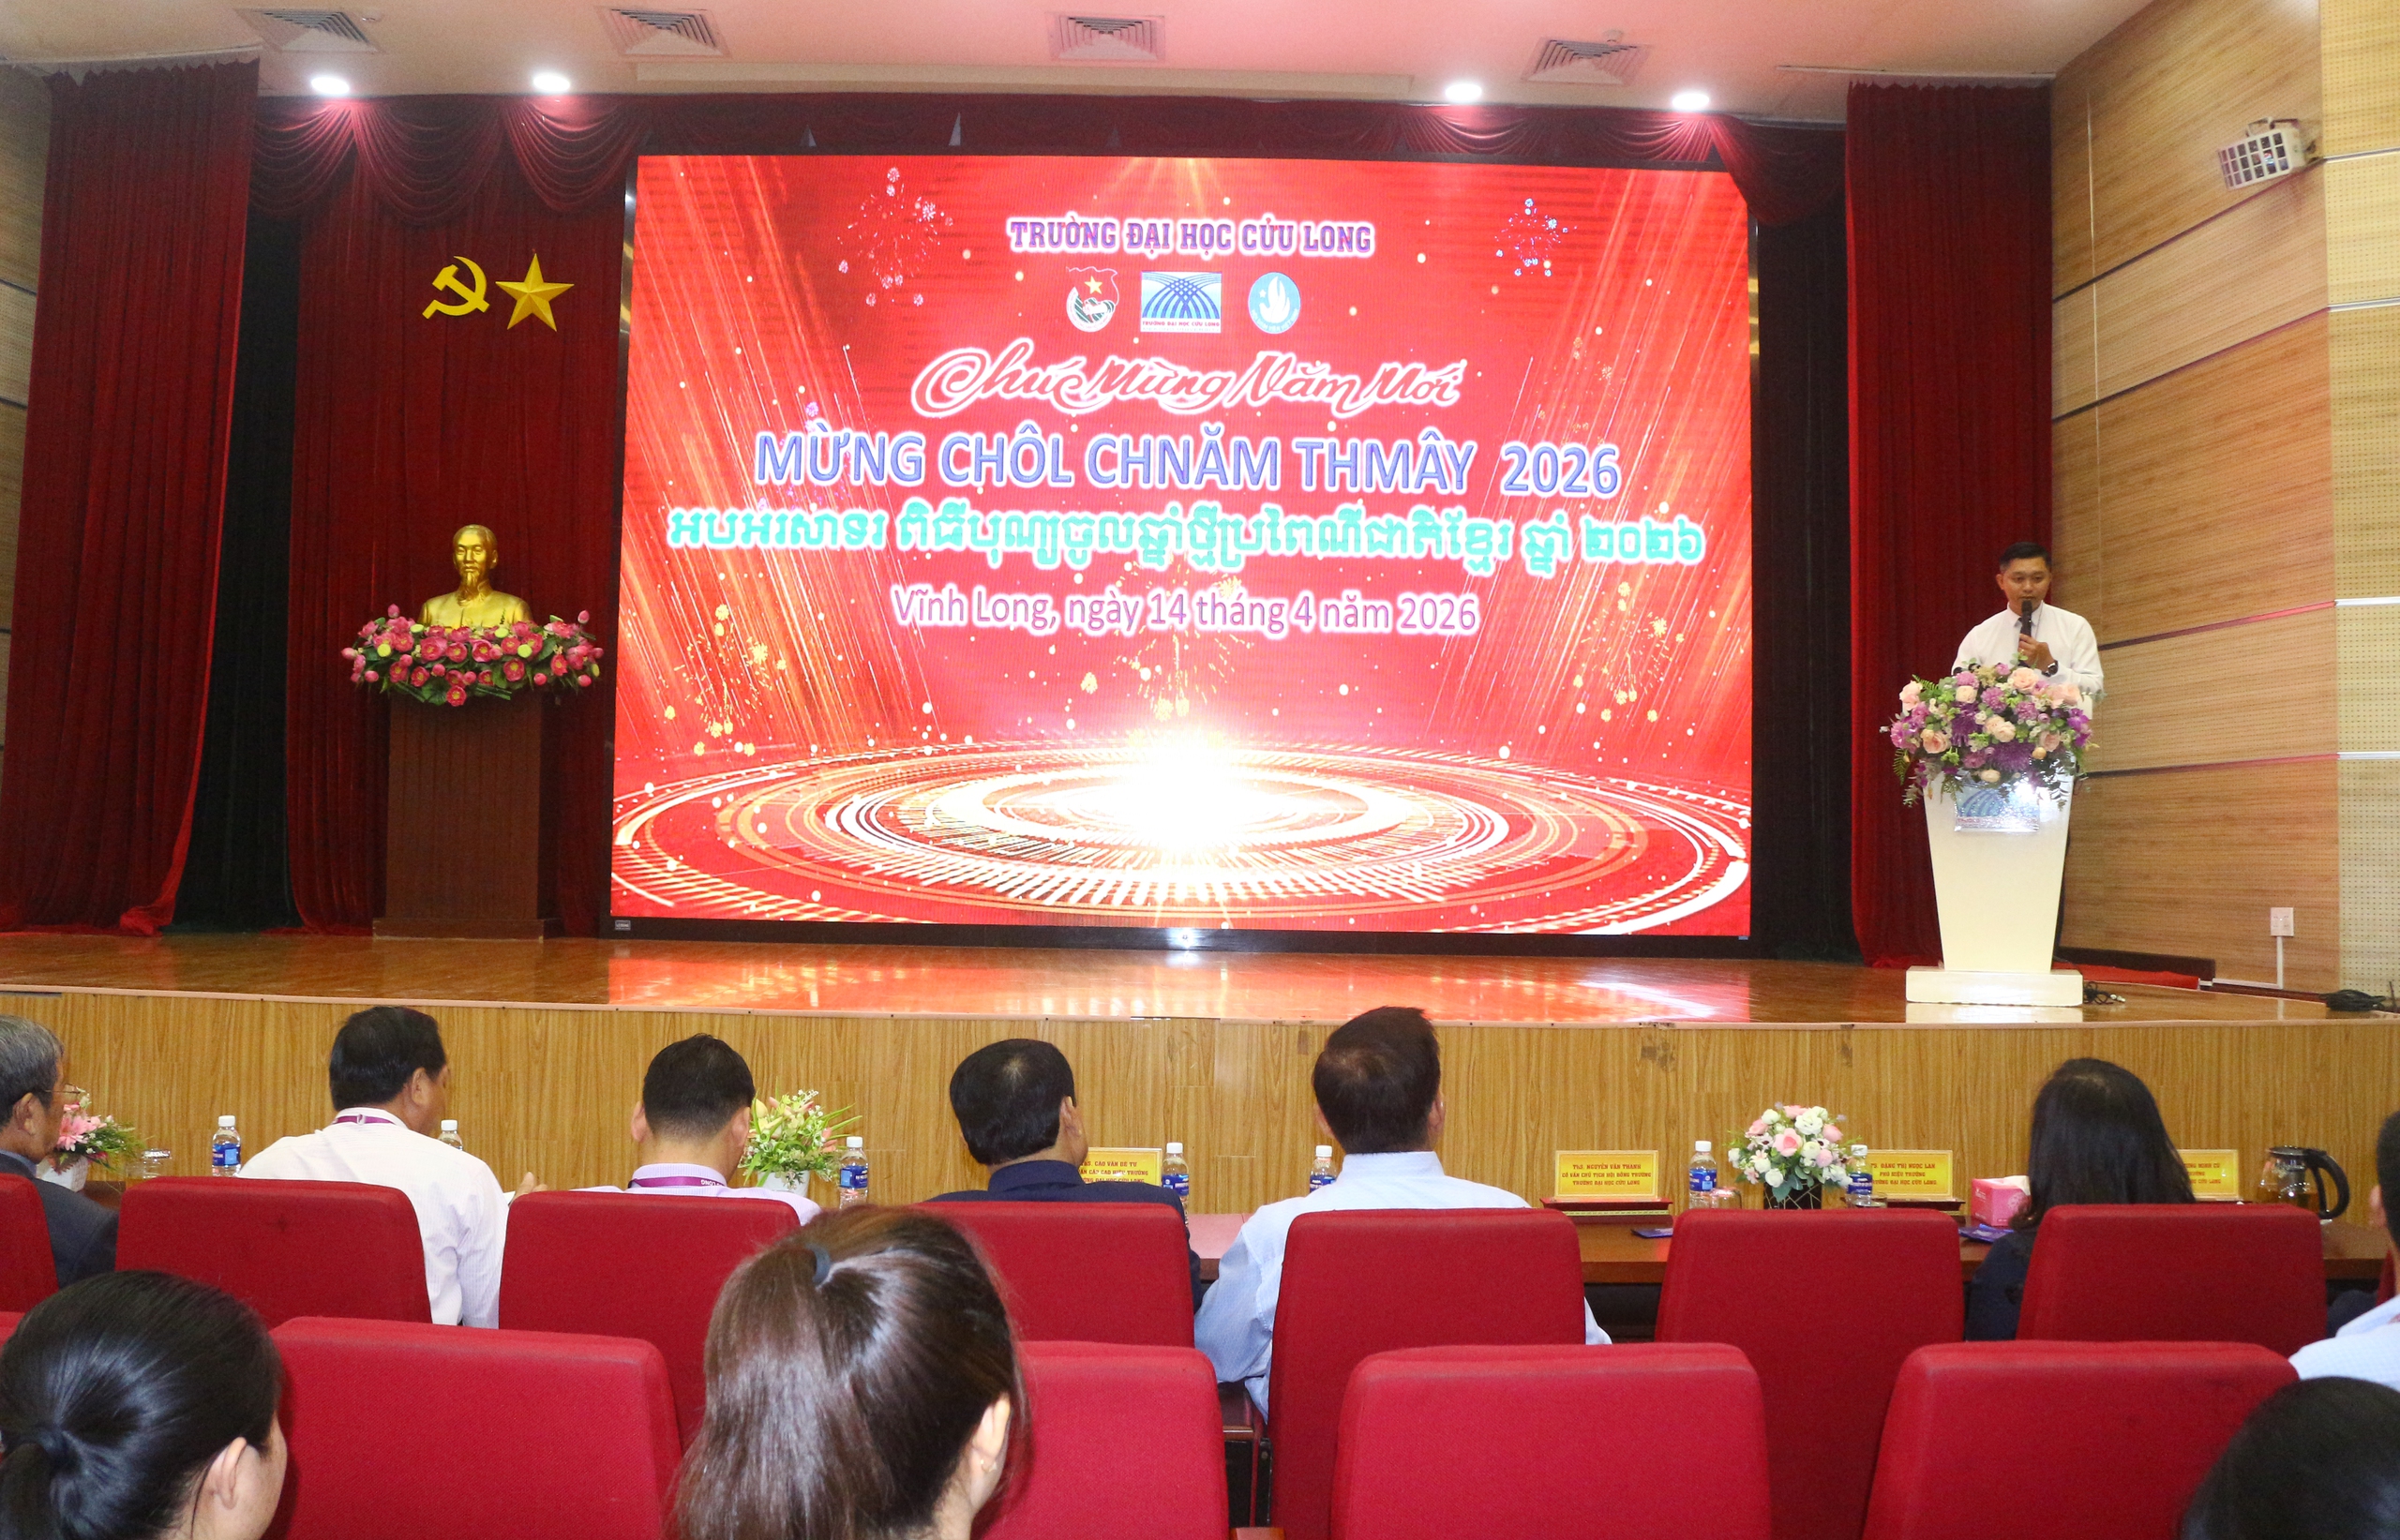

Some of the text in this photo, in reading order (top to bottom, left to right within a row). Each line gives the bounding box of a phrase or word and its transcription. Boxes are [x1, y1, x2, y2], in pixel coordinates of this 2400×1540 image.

[1010, 216, 1372, 256] TRƯỜNG ĐẠI HỌC CỬU LONG
[912, 338, 1462, 414] Chúc Mừng Năm Mới
[757, 422, 1620, 495] MỪNG CHÔL CHNĂM THMÂY 2026
[1583, 517, 1702, 561] ២០២៦
[893, 588, 1477, 634] Vĩnh Long, ngày 14 tháng 4 năm 2026
